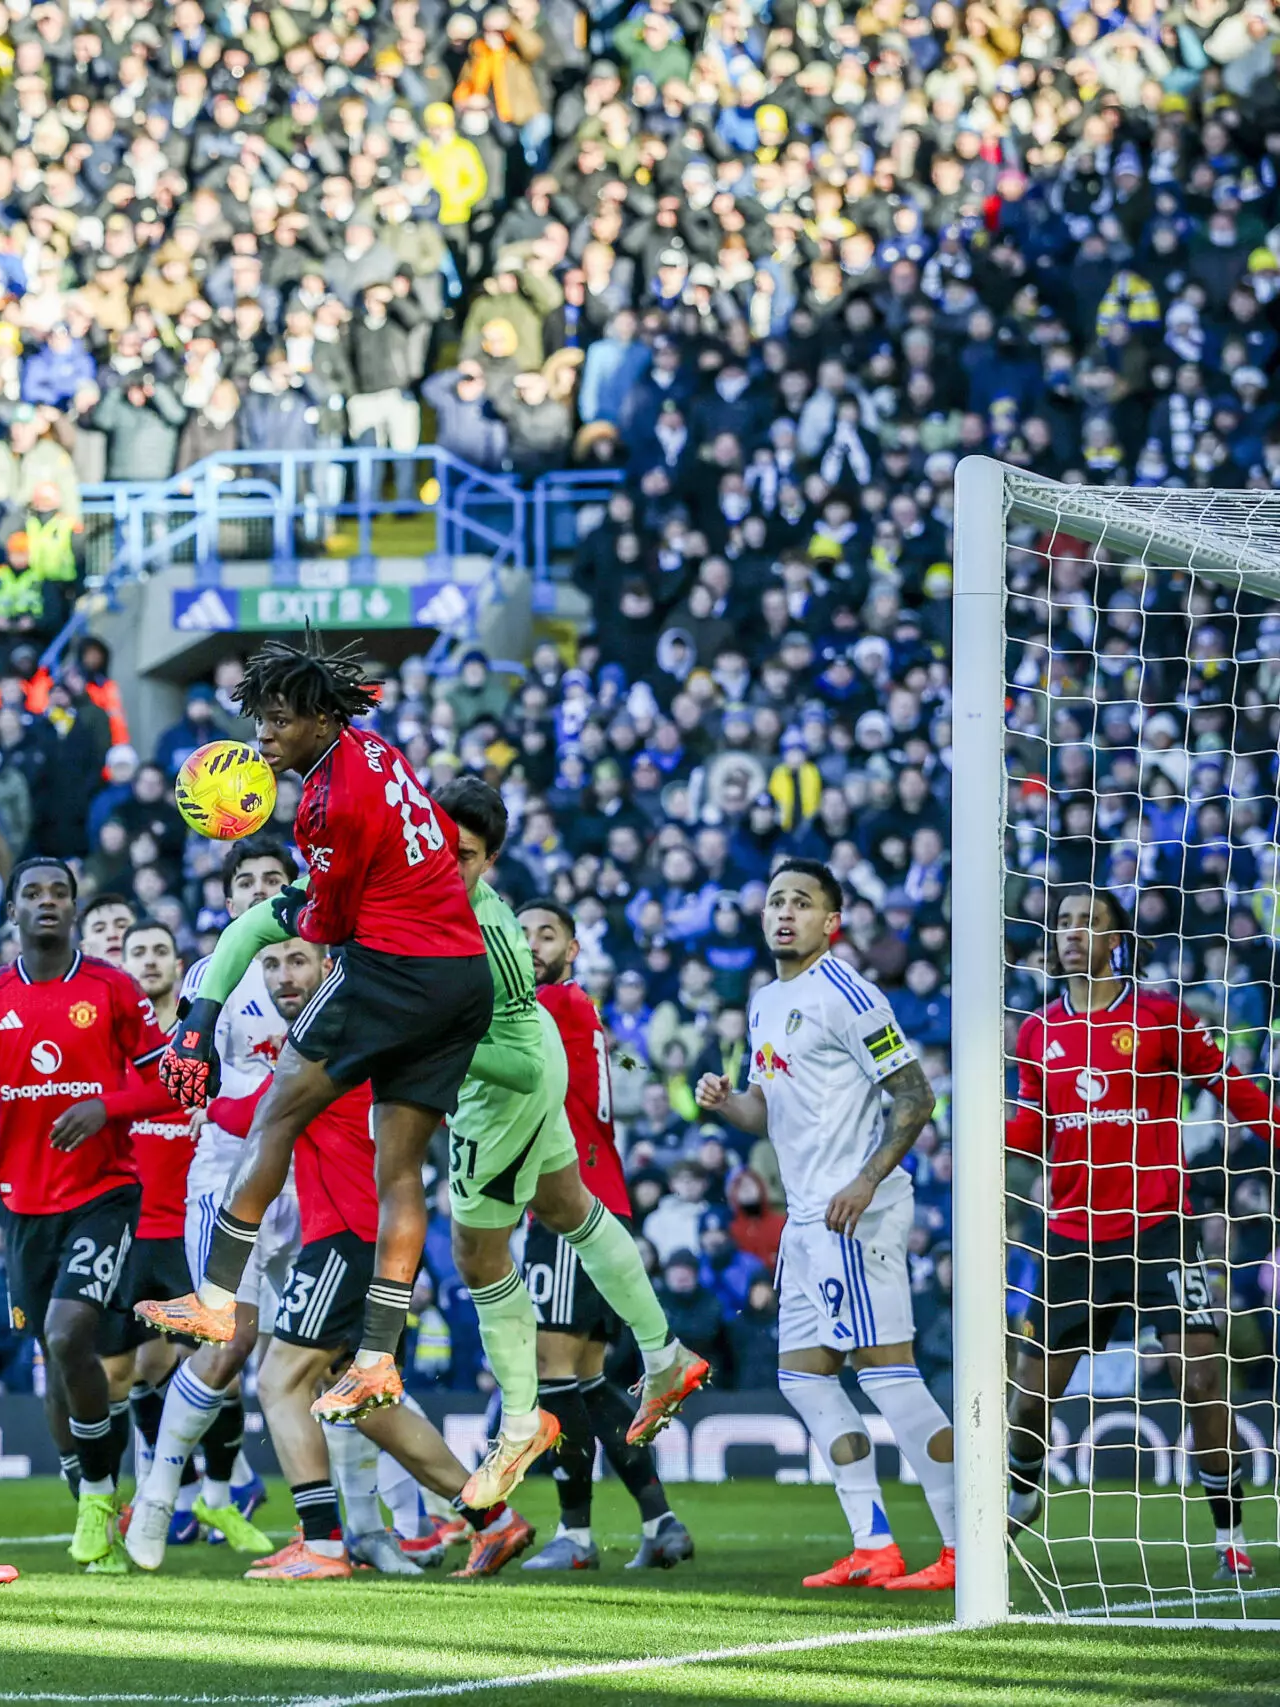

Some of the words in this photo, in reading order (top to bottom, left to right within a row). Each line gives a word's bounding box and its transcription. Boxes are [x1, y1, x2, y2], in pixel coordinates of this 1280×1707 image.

[257, 590, 334, 623] EXIT
[0, 1080, 103, 1101] Snapdragon
[1055, 1107, 1149, 1133] Snapdragon
[450, 1132, 478, 1179] 31
[66, 1236, 116, 1283] 26
[1166, 1268, 1209, 1308] 15
